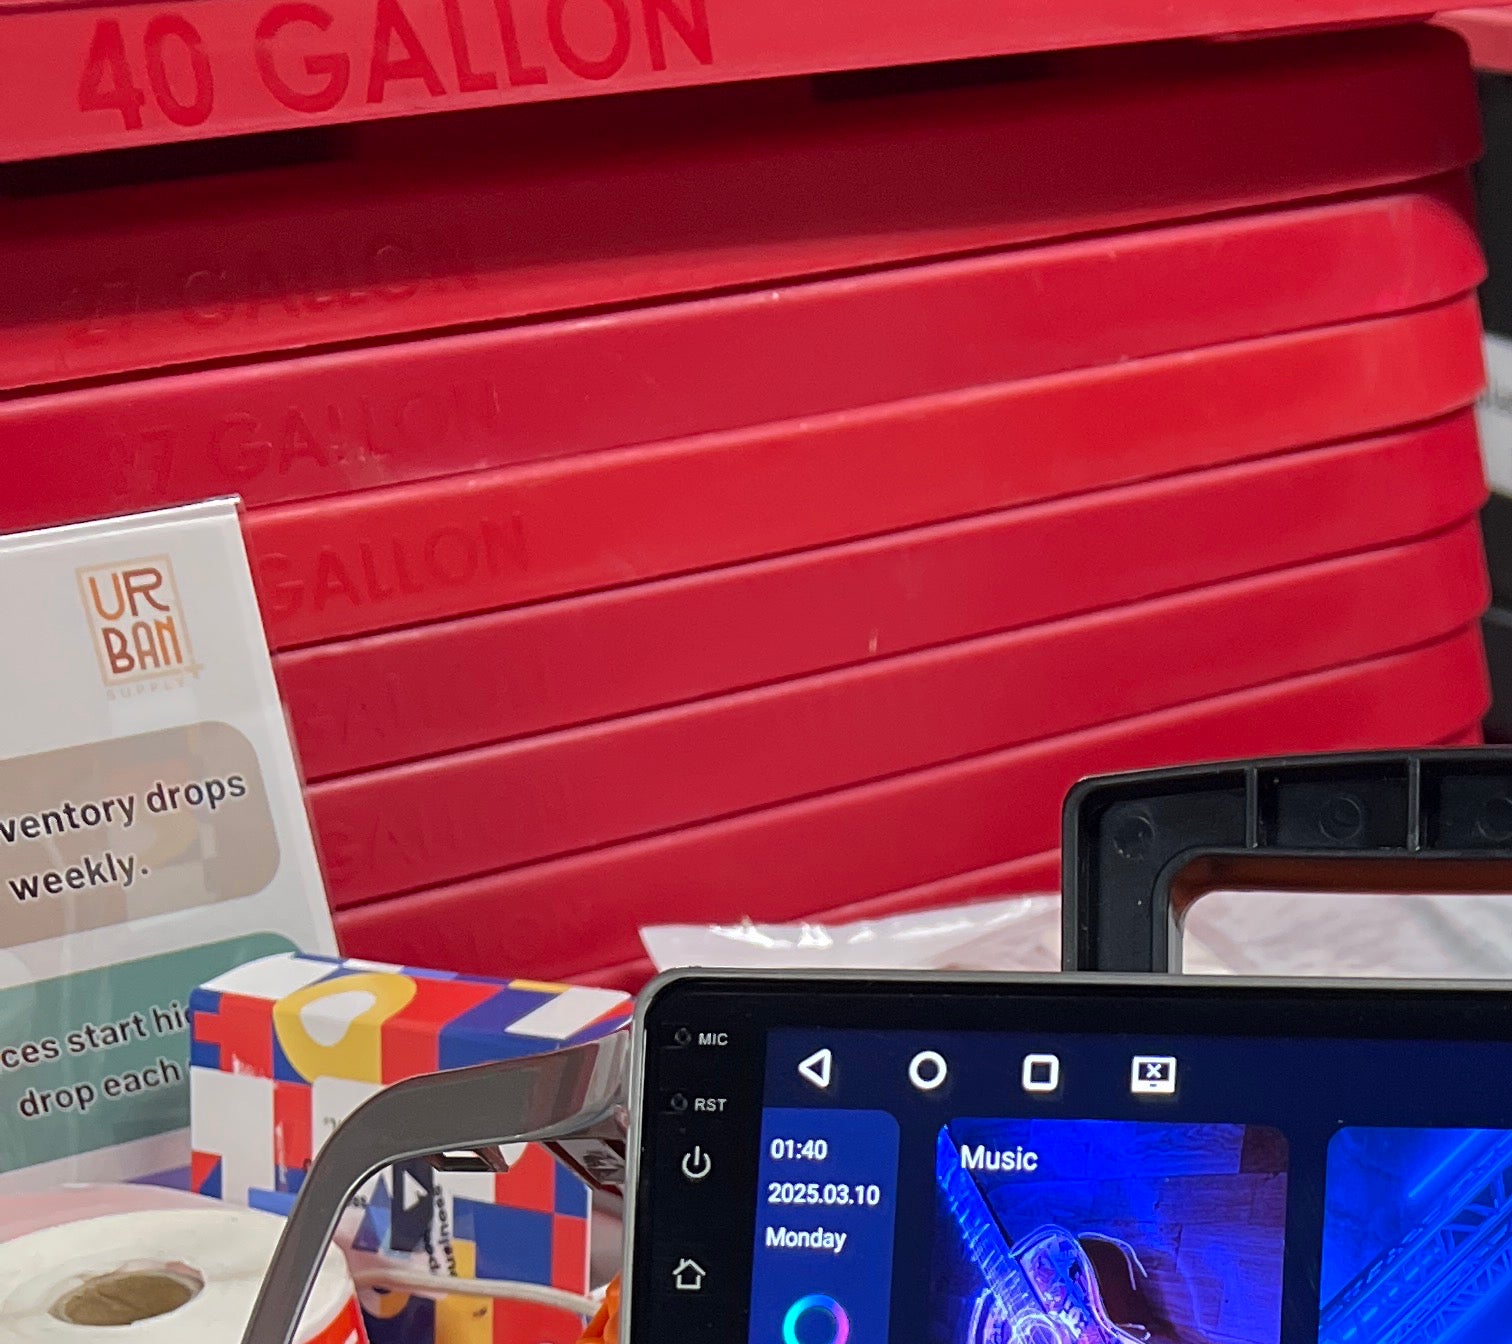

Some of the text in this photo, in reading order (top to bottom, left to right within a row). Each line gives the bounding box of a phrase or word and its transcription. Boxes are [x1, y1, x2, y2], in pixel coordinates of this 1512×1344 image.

[77, 0, 714, 131] 40 GALLON
[260, 510, 530, 615] GALLON
[88, 567, 170, 621] UR
[102, 615, 183, 674] BAN
[0, 775, 247, 843] ventory drops
[9, 853, 148, 901] weekly.
[1, 1038, 60, 1068] ces
[67, 1015, 147, 1053] start
[698, 1033, 728, 1046] MIC
[19, 1059, 180, 1117] drop each
[694, 1098, 727, 1112] RST
[770, 1139, 828, 1161] 01:40
[960, 1145, 1039, 1172] Music
[767, 1183, 880, 1207] 2025.03.10
[765, 1227, 847, 1254] Monday
